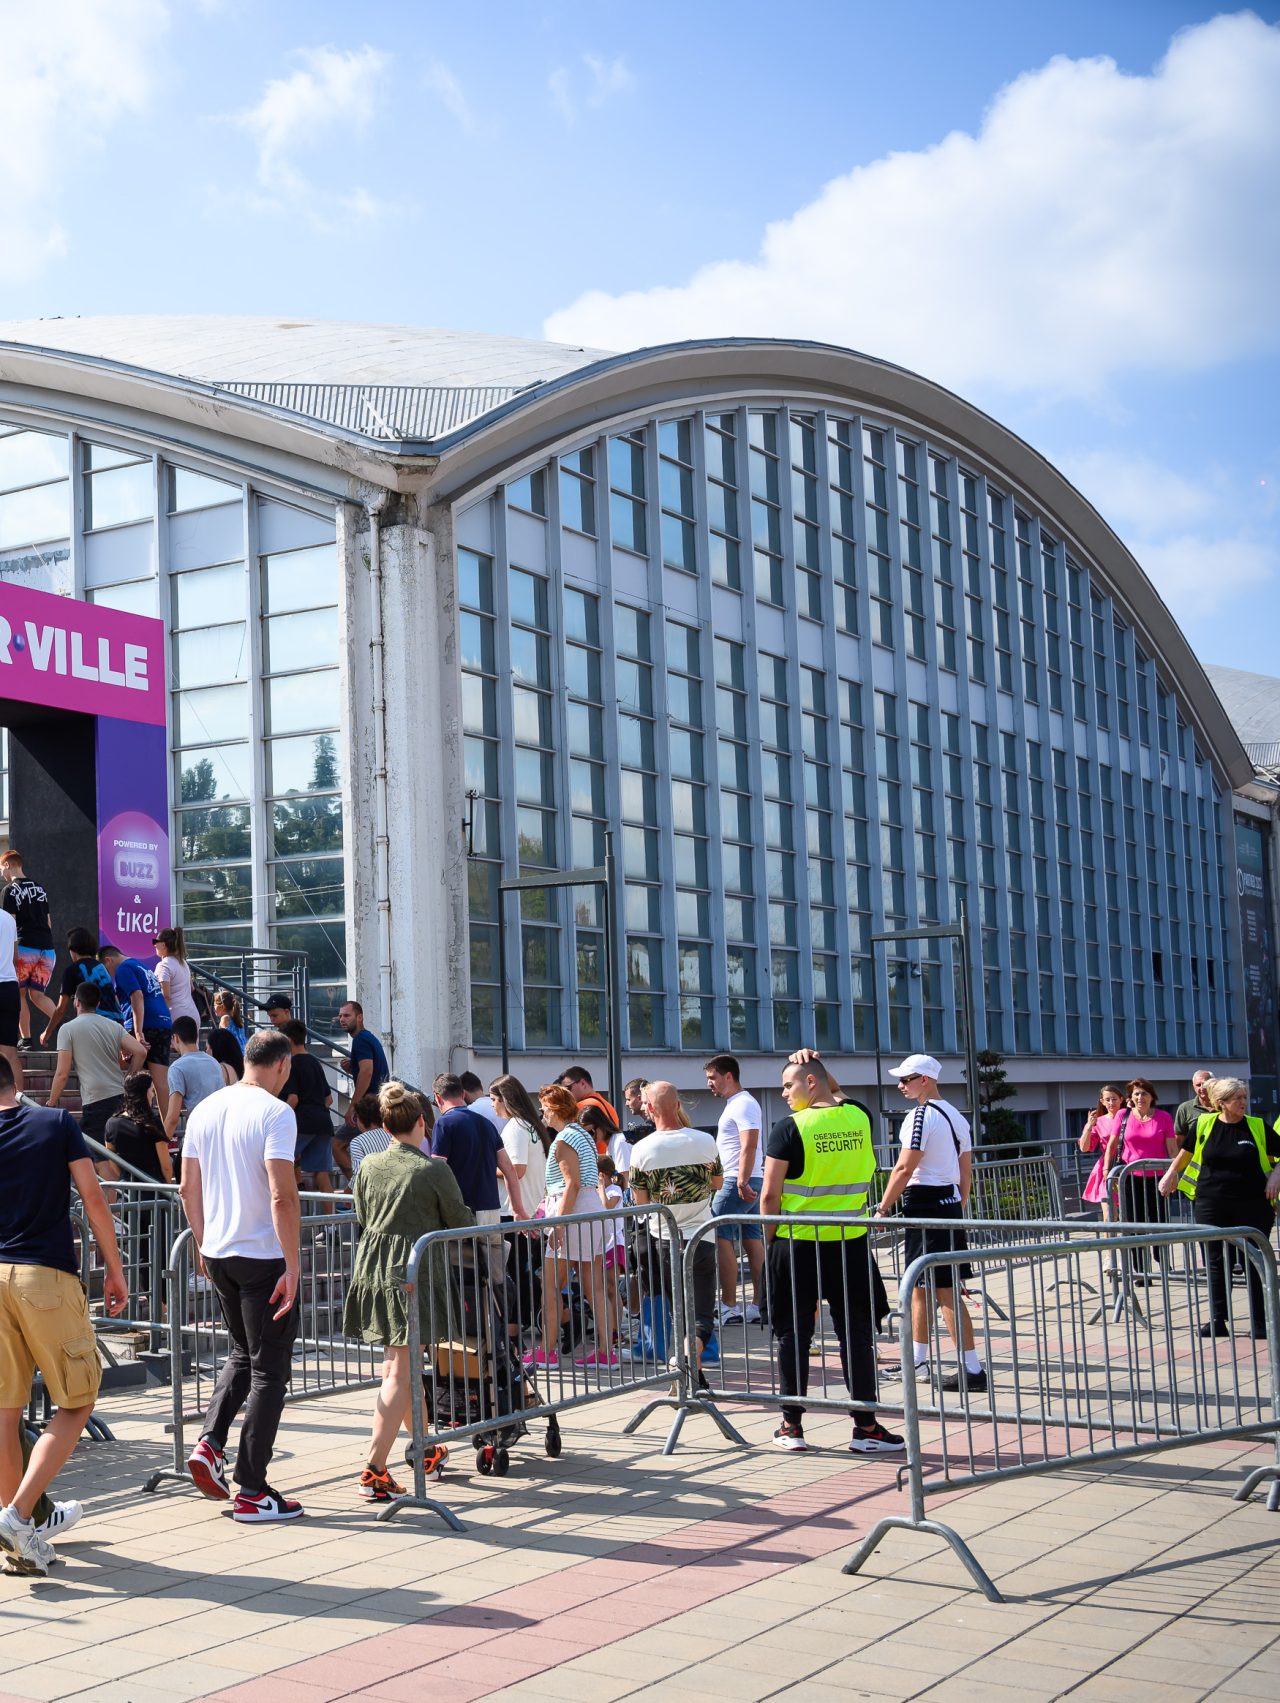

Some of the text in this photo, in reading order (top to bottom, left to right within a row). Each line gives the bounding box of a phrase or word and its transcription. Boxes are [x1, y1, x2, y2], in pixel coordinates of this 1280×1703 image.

[24, 621, 149, 692] VILLE
[113, 839, 158, 851] POWERED BY
[133, 894, 142, 904] &
[815, 1138, 864, 1153] SECURITY
